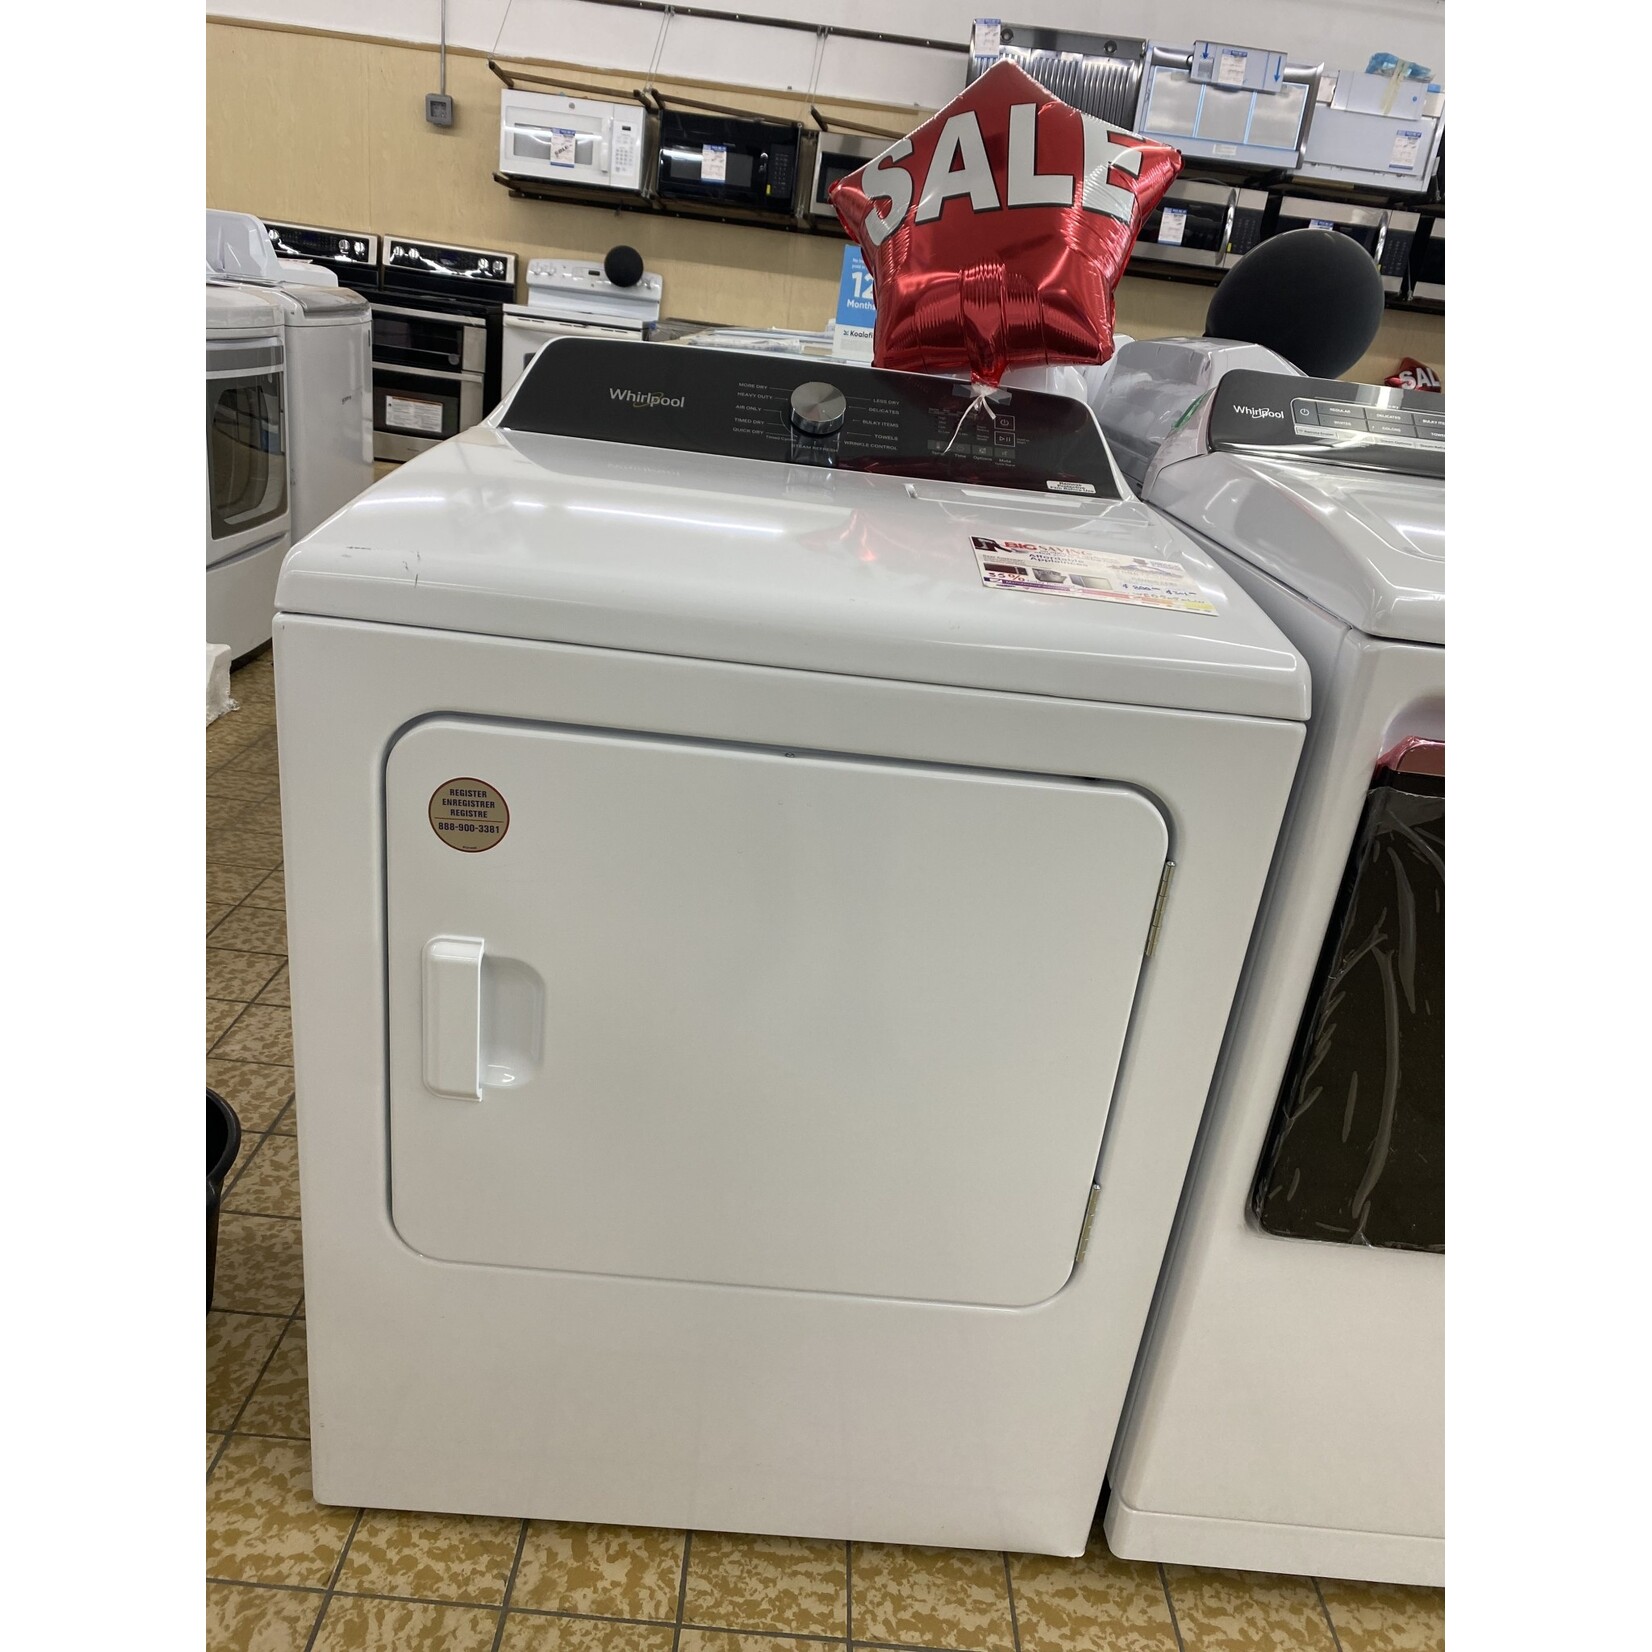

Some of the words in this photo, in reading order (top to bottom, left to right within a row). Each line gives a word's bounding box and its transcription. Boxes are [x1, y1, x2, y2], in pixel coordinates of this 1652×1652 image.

[861, 103, 1146, 246] SALE
[851, 271, 874, 299] 12
[846, 299, 876, 311] Months
[609, 387, 685, 408] Whirlpool
[868, 407, 900, 415] DELICATES
[1233, 404, 1284, 419] Whirlpool
[844, 440, 869, 448] WRINKLE
[1003, 541, 1037, 551] BIG
[449, 788, 487, 798] REGISTER
[442, 798, 495, 808] ENREGISTRER
[450, 809, 488, 818] REGISTRE
[438, 822, 499, 833] 888-900-3381
